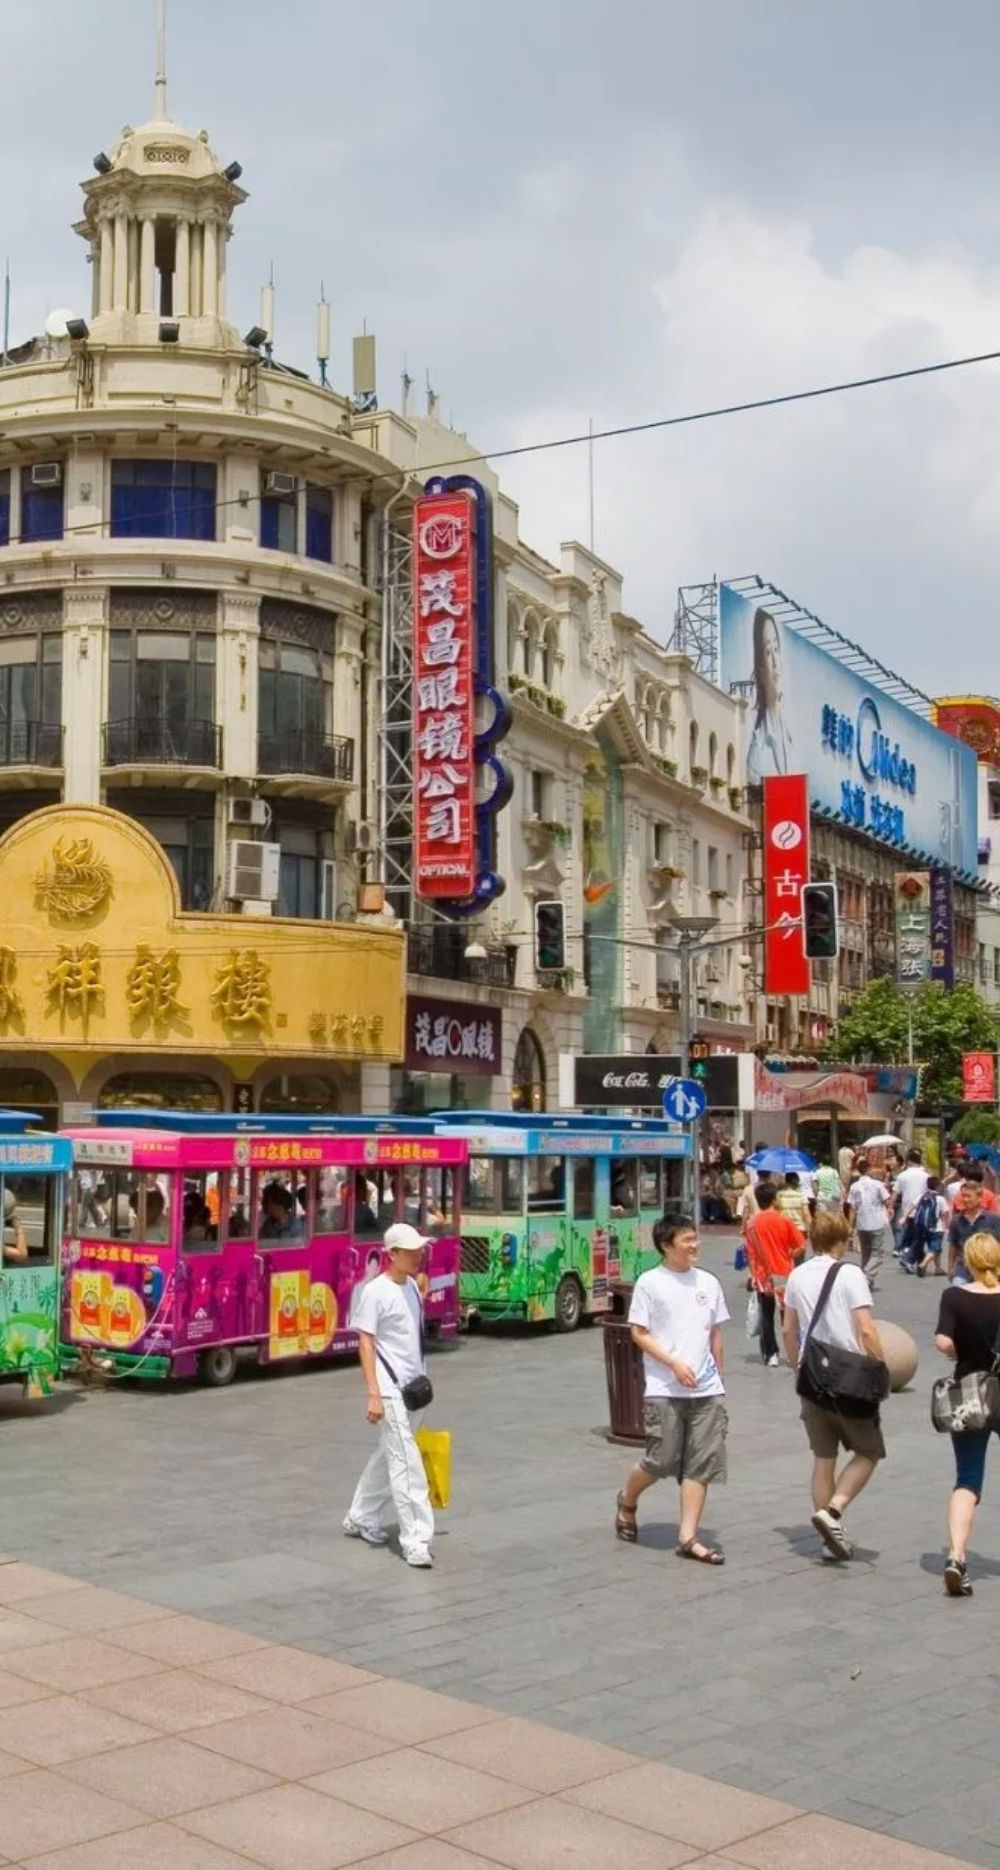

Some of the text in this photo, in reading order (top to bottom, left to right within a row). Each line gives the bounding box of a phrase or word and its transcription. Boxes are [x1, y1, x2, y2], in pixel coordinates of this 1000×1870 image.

[417, 571, 468, 845] 茂昌眼镜公司
[419, 863, 466, 877] OPTICAL
